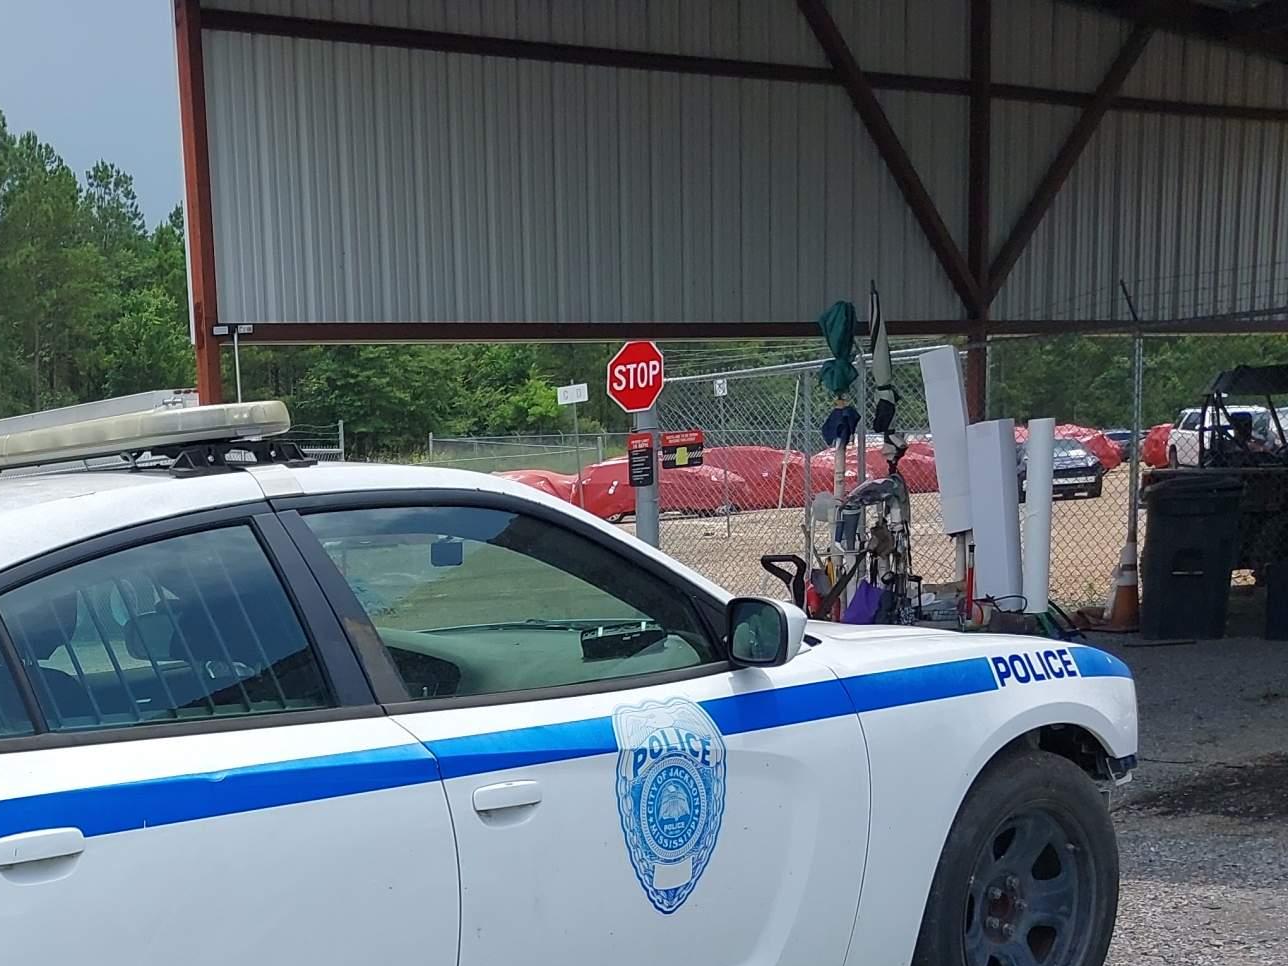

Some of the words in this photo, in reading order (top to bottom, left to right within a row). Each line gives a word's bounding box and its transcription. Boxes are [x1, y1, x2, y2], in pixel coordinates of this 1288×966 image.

[613, 360, 660, 391] STOP
[991, 648, 1078, 688] POLICE
[633, 727, 713, 779] POLICE
[647, 785, 659, 814] CITY
[656, 769, 668, 785] OF
[668, 767, 701, 807] JACKSON
